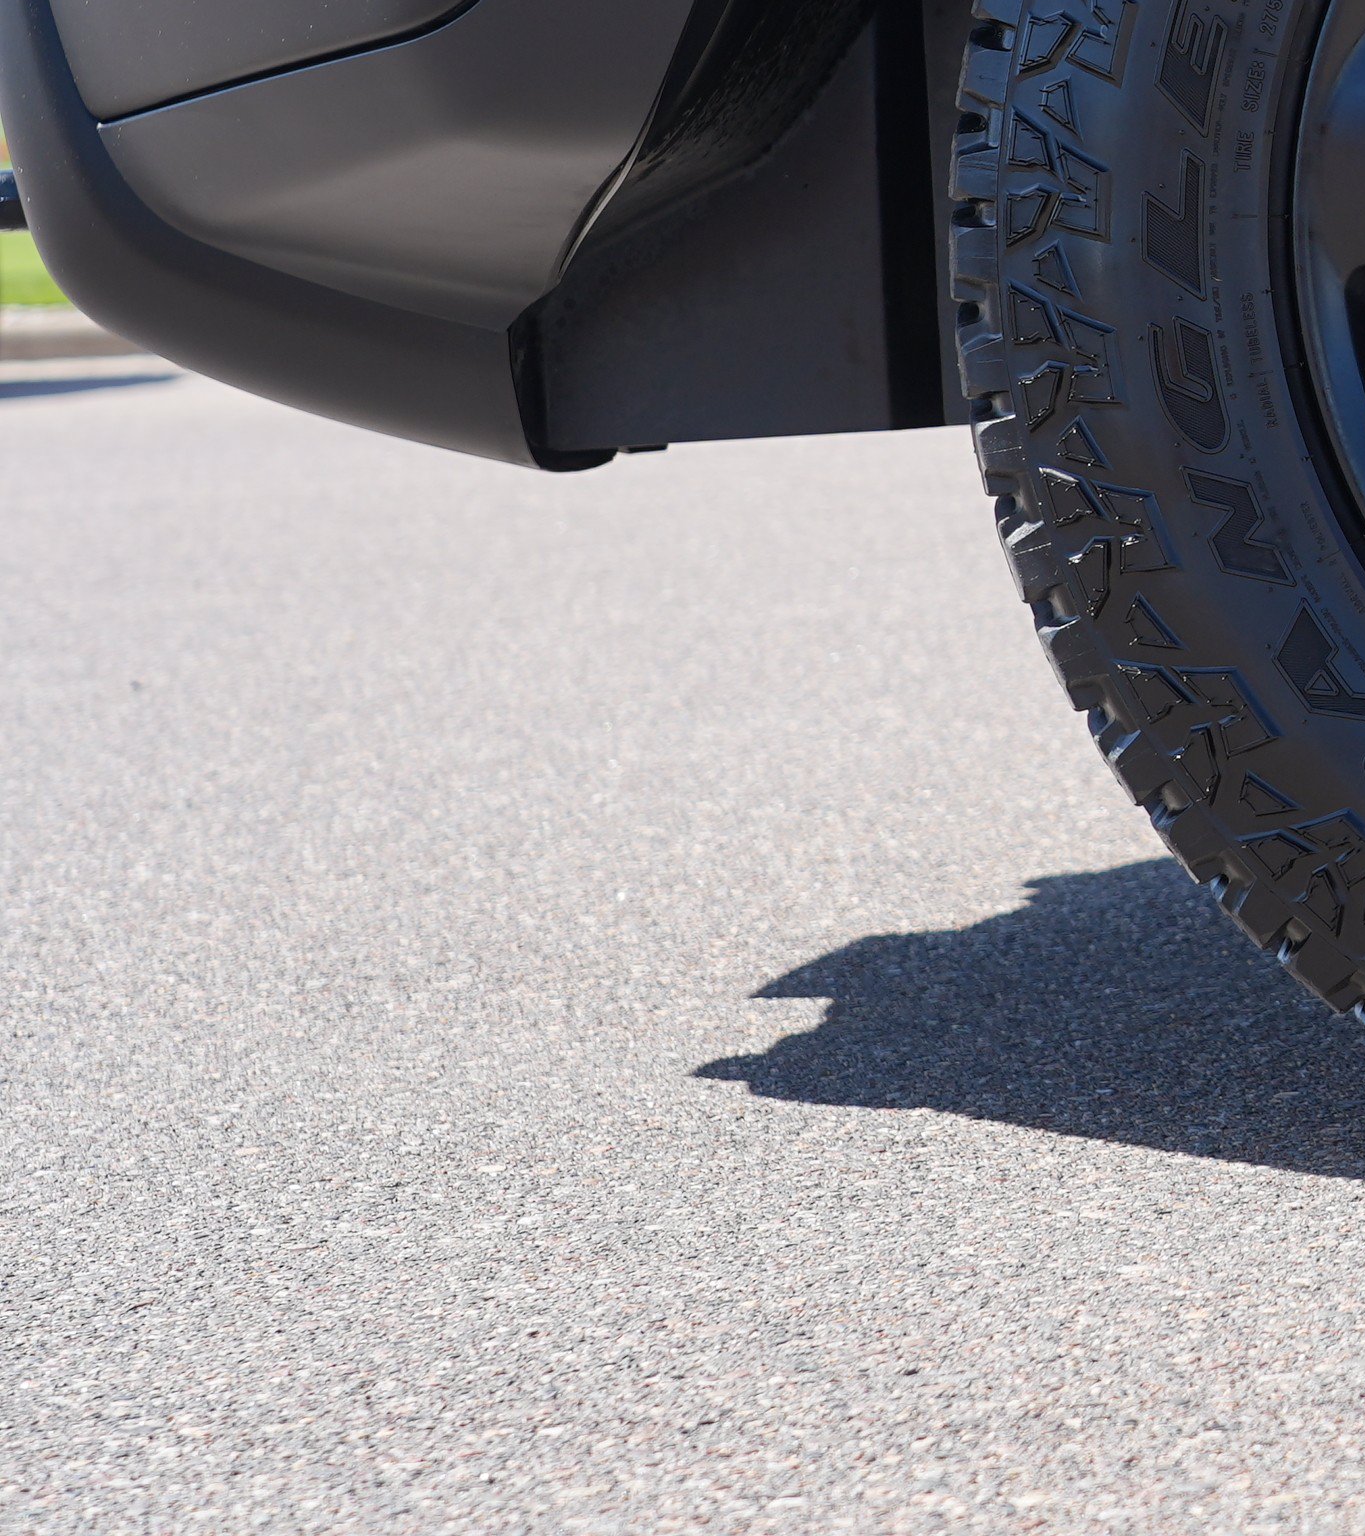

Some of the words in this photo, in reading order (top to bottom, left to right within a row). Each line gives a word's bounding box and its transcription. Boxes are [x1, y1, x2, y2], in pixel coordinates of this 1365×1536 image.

[1239, 58, 1268, 114] SIZE:
[1232, 128, 1255, 173] TIRE
[1239, 290, 1265, 365] TUBELESS
[1253, 376, 1280, 430] RADIAL
